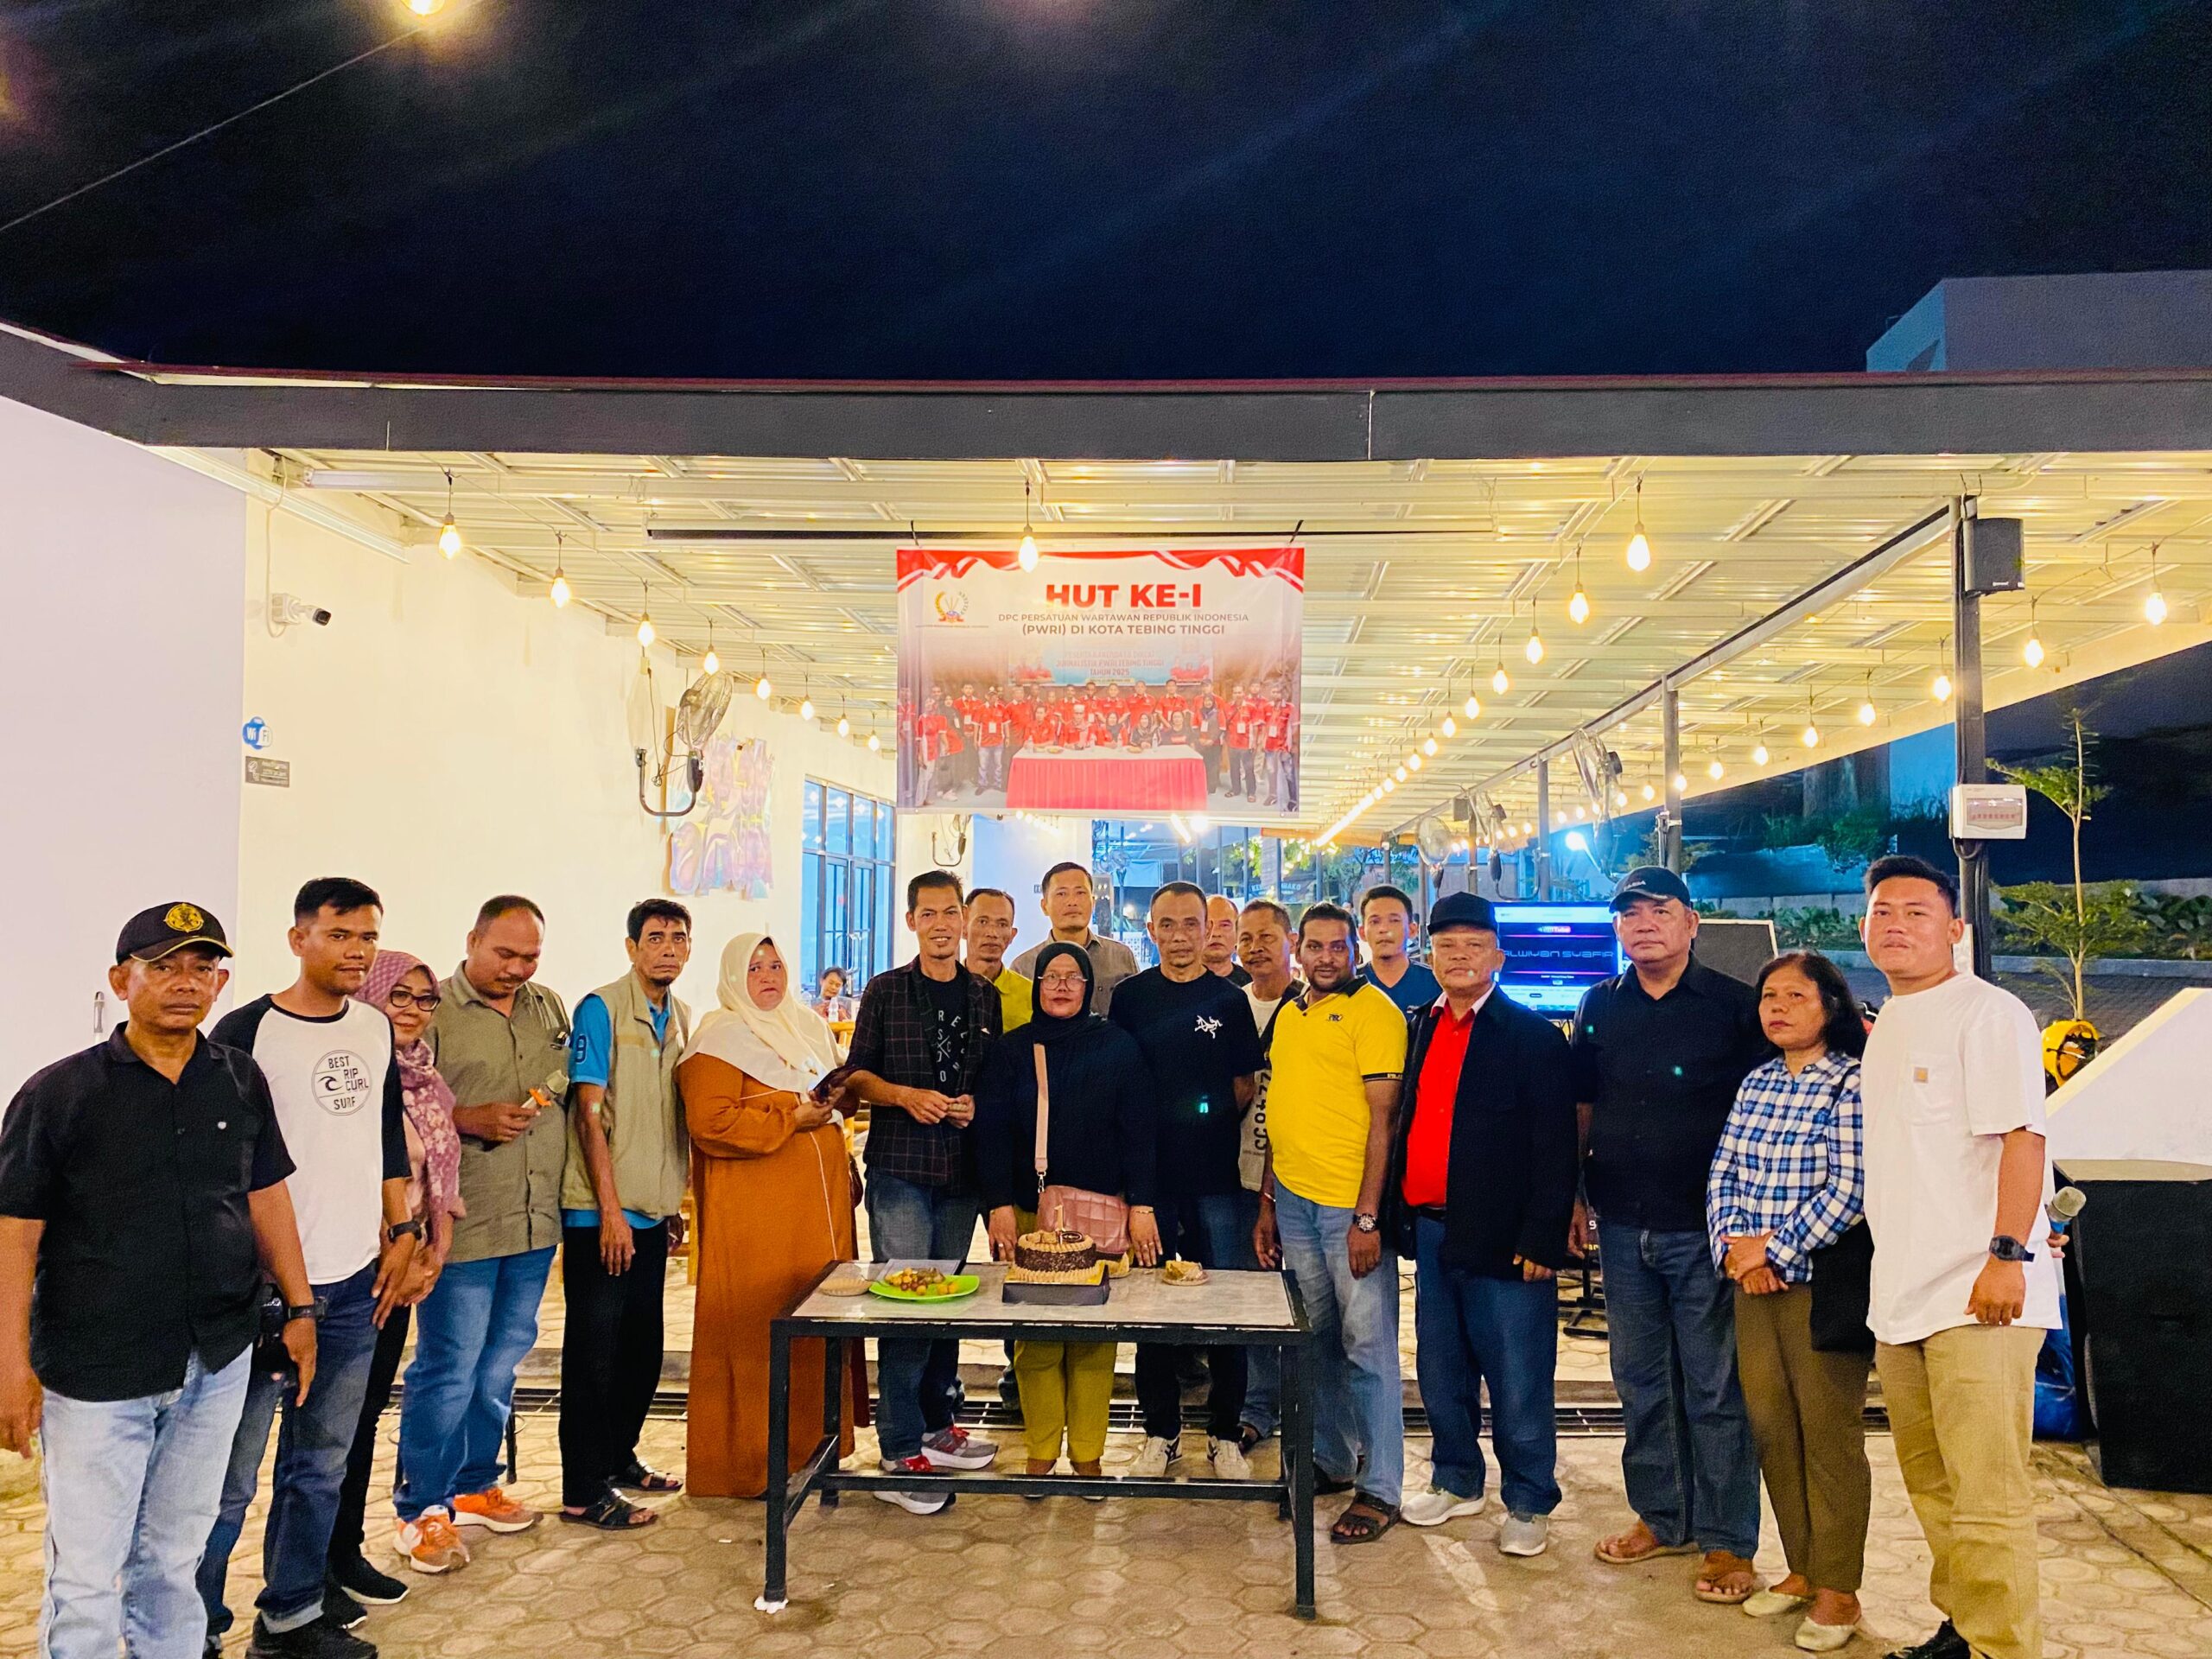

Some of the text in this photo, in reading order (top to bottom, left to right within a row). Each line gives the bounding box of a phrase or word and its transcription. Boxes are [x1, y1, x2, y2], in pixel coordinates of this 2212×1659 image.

[1046, 584, 1201, 607] HUT KE-I
[1022, 624, 1224, 636] (PWRI) DI KOTA TEBING TINGGI
[328, 1056, 349, 1069] BEST
[343, 1068, 359, 1080] RIP
[346, 1078, 369, 1091] CURL
[334, 1096, 356, 1110] SURF
